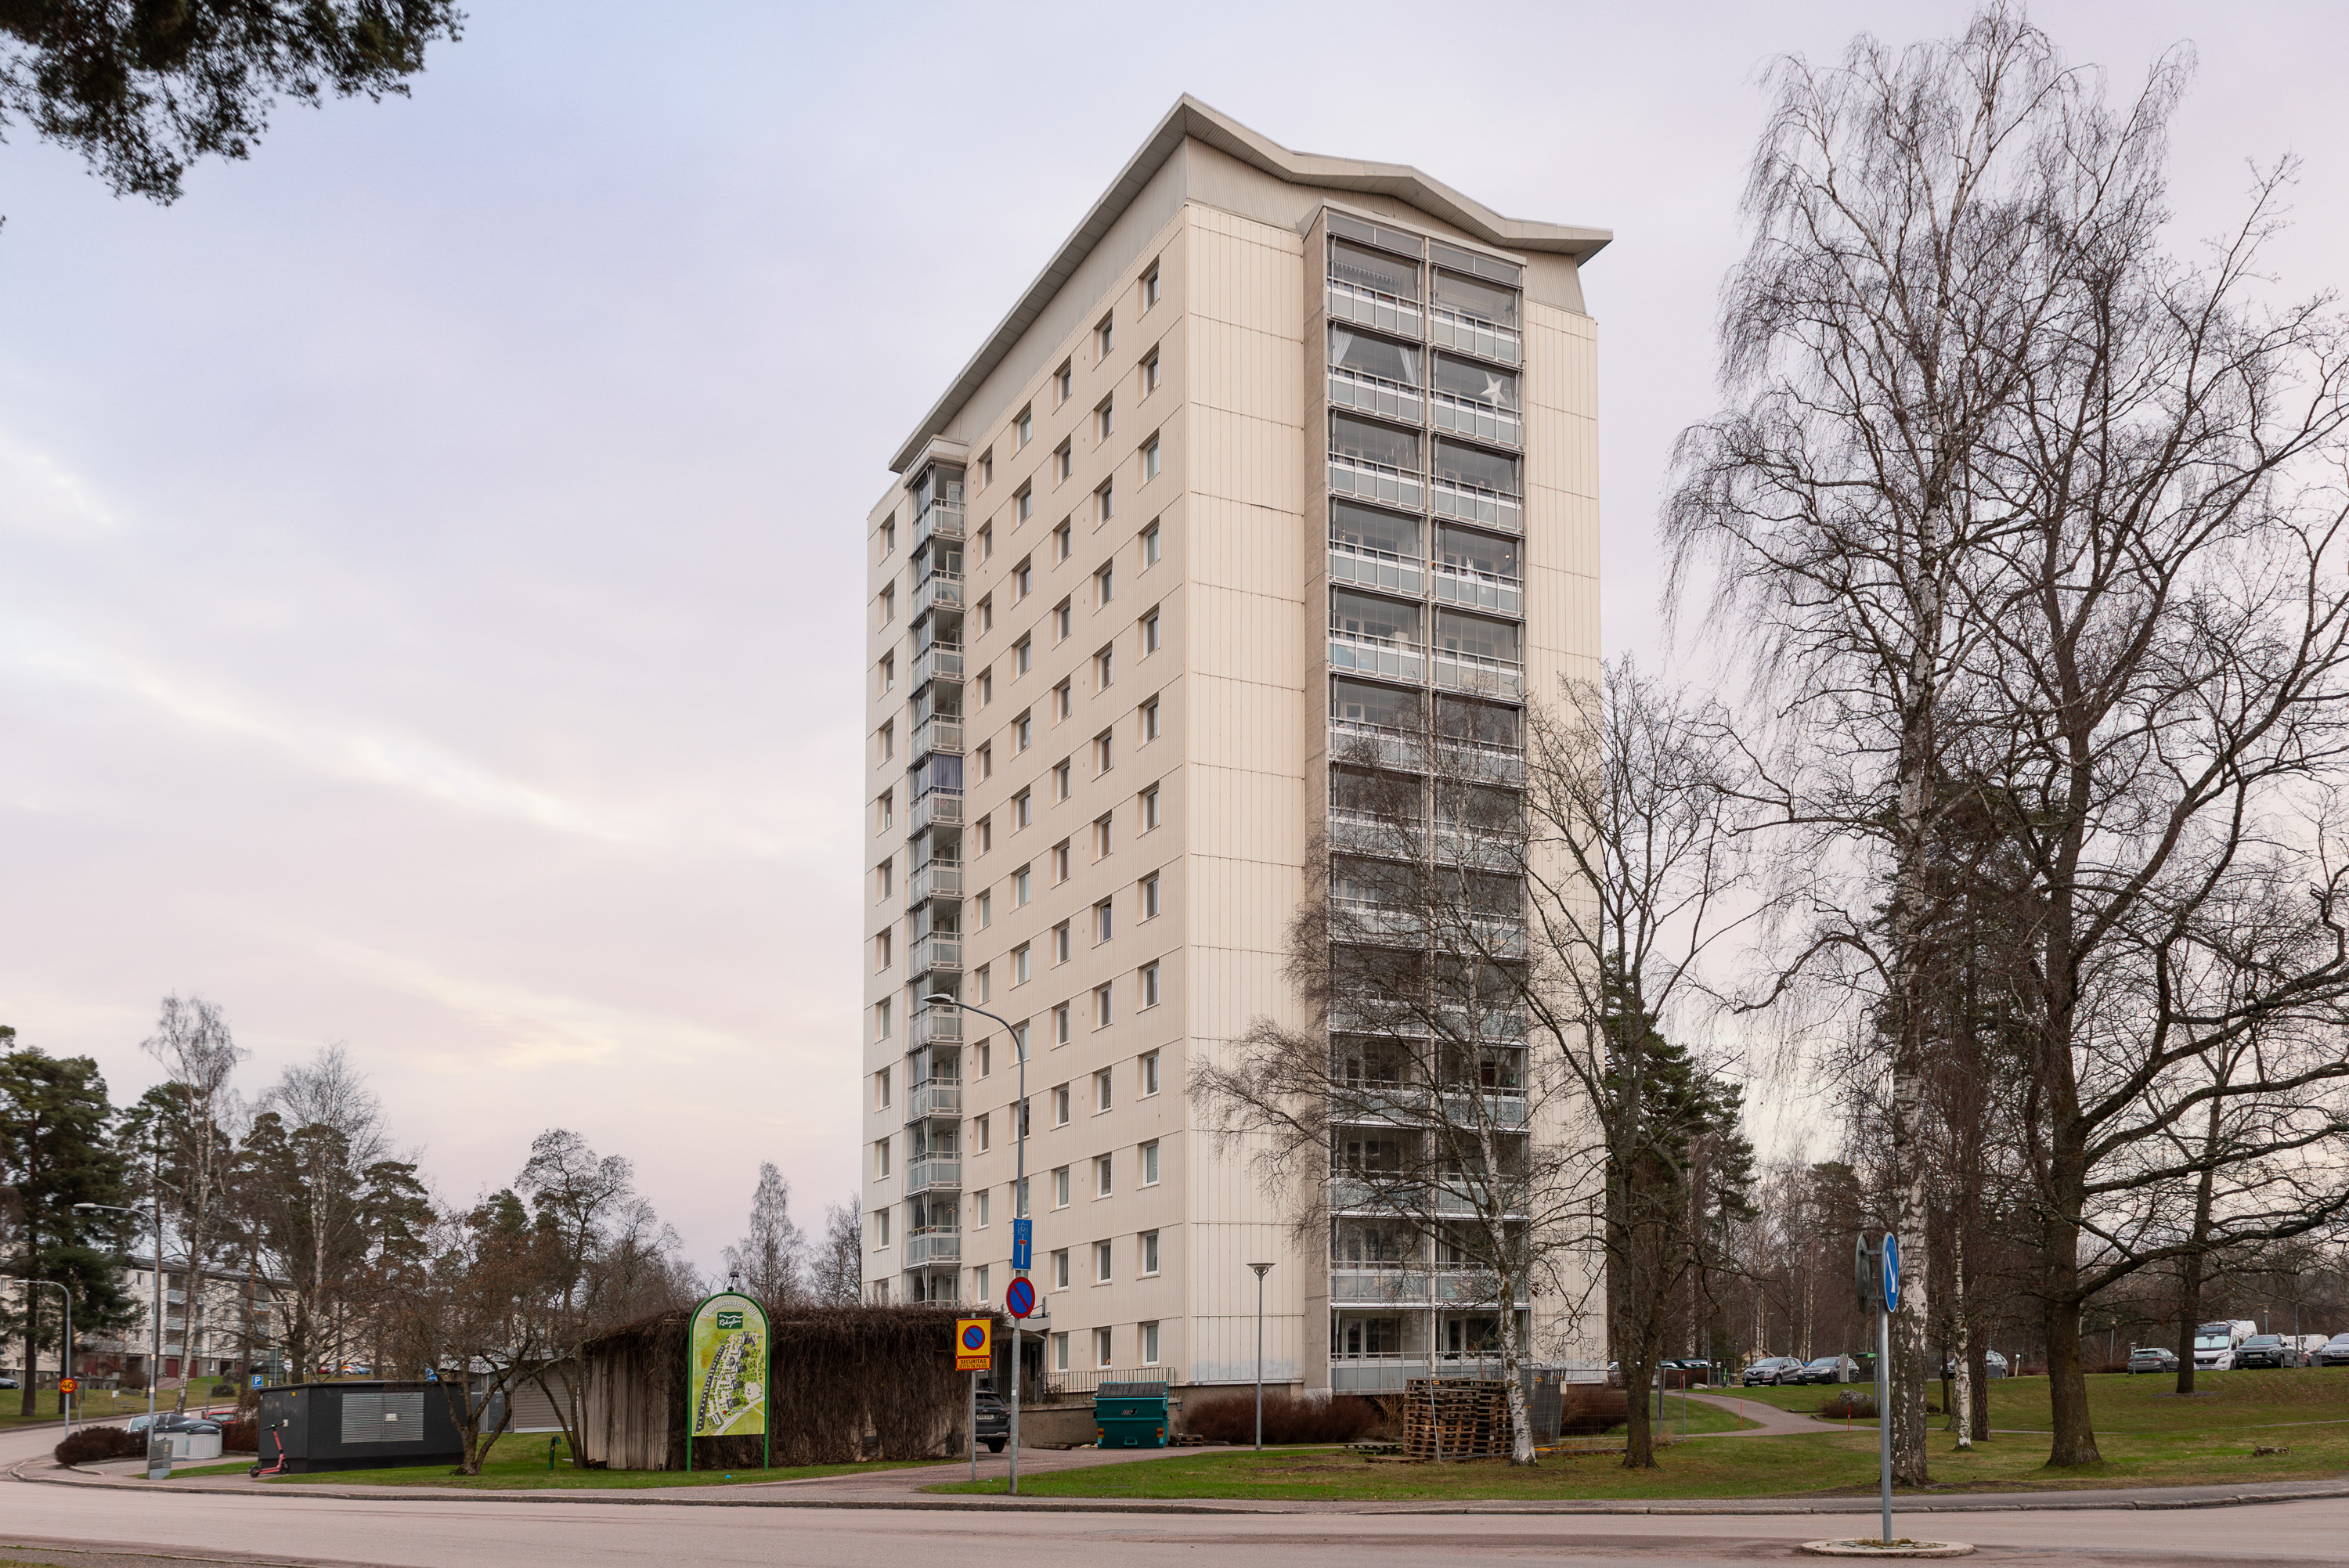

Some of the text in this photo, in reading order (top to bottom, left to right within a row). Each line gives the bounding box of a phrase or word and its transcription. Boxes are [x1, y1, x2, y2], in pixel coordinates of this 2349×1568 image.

[702, 1299, 757, 1317] Välkommen till
[254, 1376, 261, 1385] P
